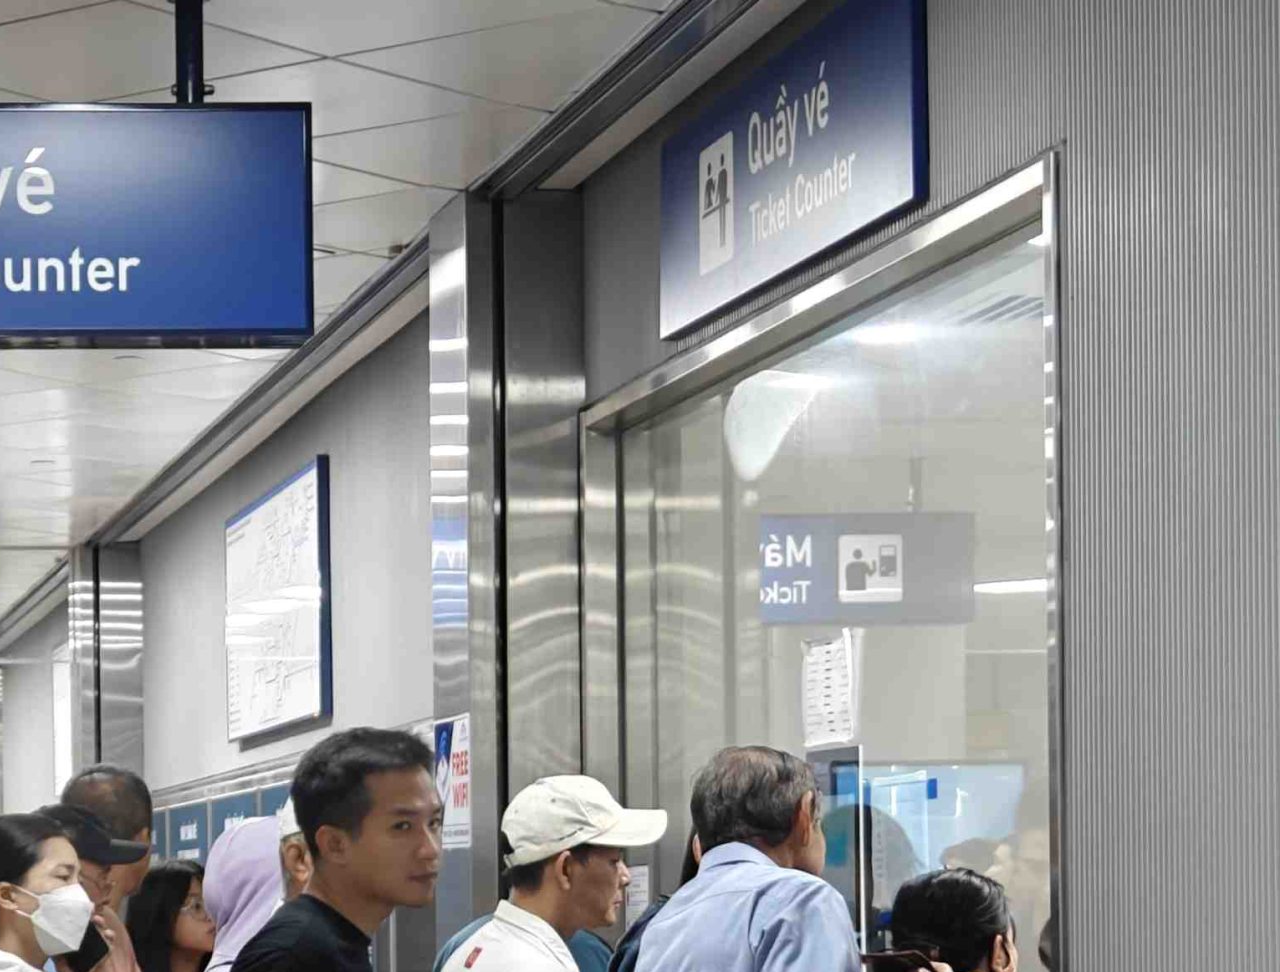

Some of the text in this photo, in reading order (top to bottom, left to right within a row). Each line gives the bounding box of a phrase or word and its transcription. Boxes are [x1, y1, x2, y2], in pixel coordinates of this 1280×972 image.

[748, 60, 830, 174] Quầy vé
[748, 152, 856, 246] Ticket Counter
[451, 750, 469, 777] FREE
